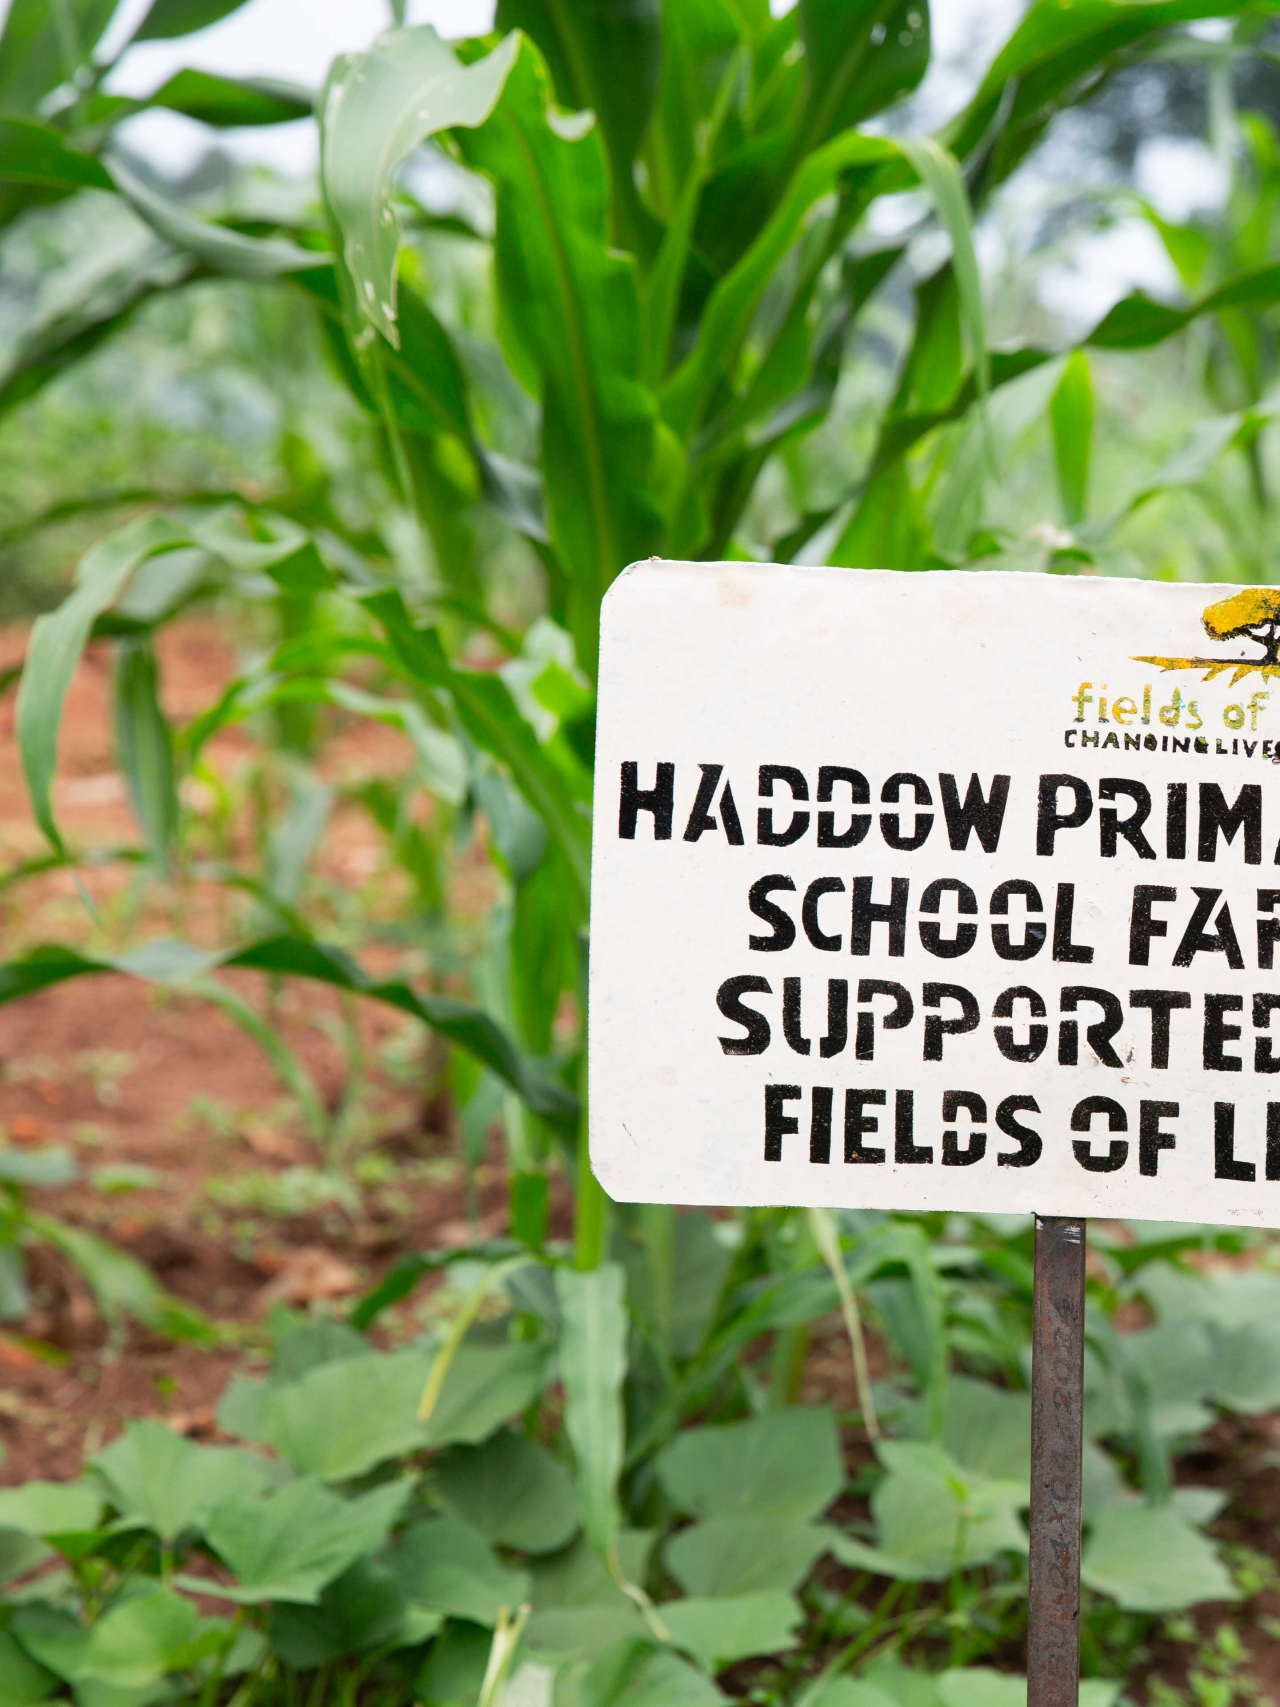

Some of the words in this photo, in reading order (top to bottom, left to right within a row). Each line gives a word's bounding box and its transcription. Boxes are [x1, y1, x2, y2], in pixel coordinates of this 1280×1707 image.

[1072, 682, 1204, 730] fields
[1223, 691, 1269, 732] of
[618, 760, 1011, 854] HADDOW
[748, 874, 1095, 965] SCHOOL
[763, 1083, 1044, 1169] FIELDS
[1070, 1095, 1180, 1178] OF
